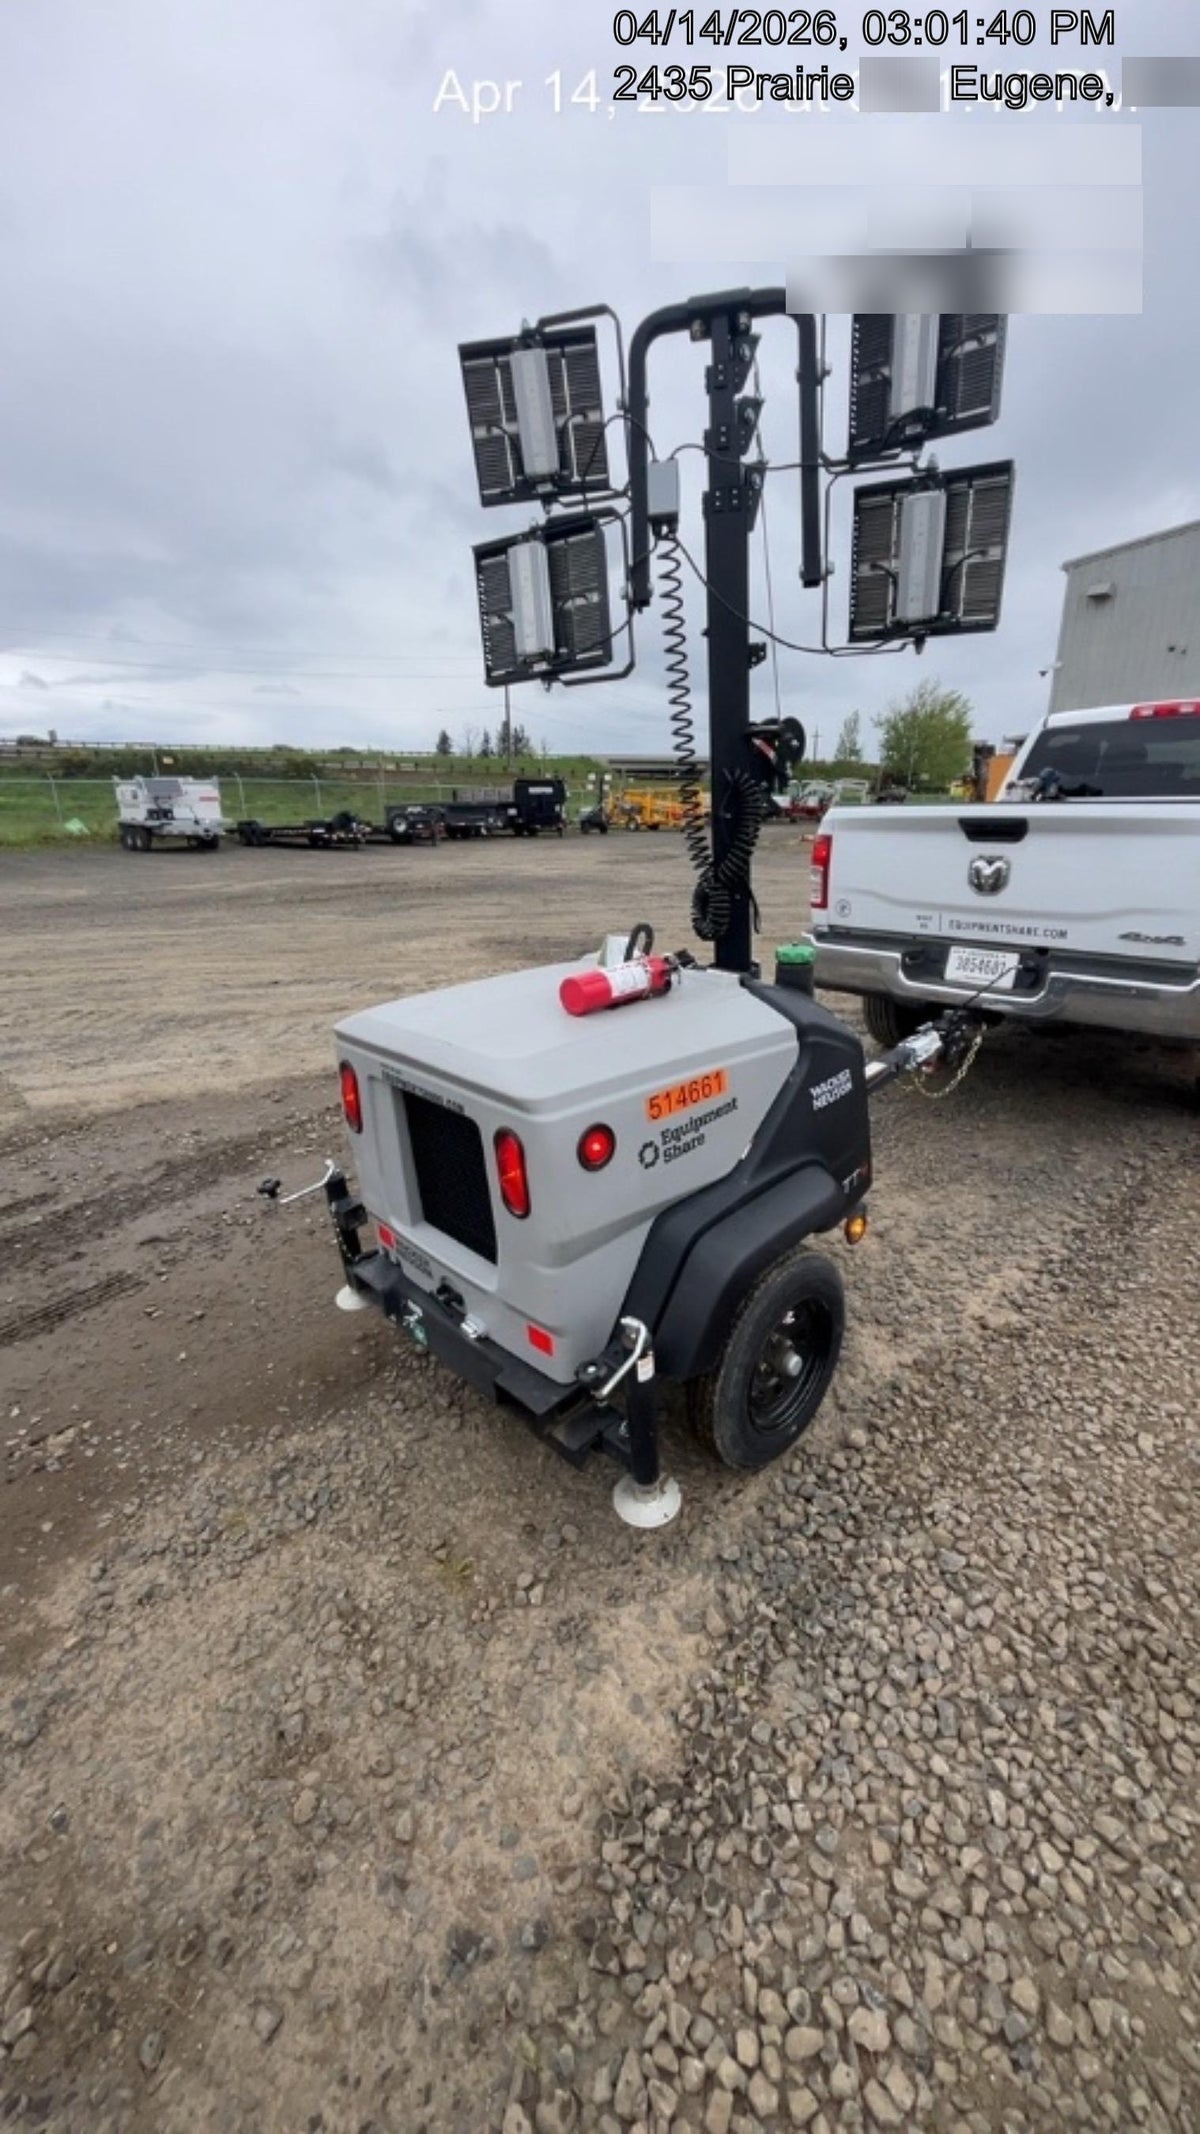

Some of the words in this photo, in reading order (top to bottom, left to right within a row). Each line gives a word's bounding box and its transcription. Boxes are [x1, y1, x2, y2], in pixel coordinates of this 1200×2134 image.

[648, 1072, 722, 1119] 514661
[661, 1097, 738, 1146] Equipment
[663, 1133, 705, 1164] Share
